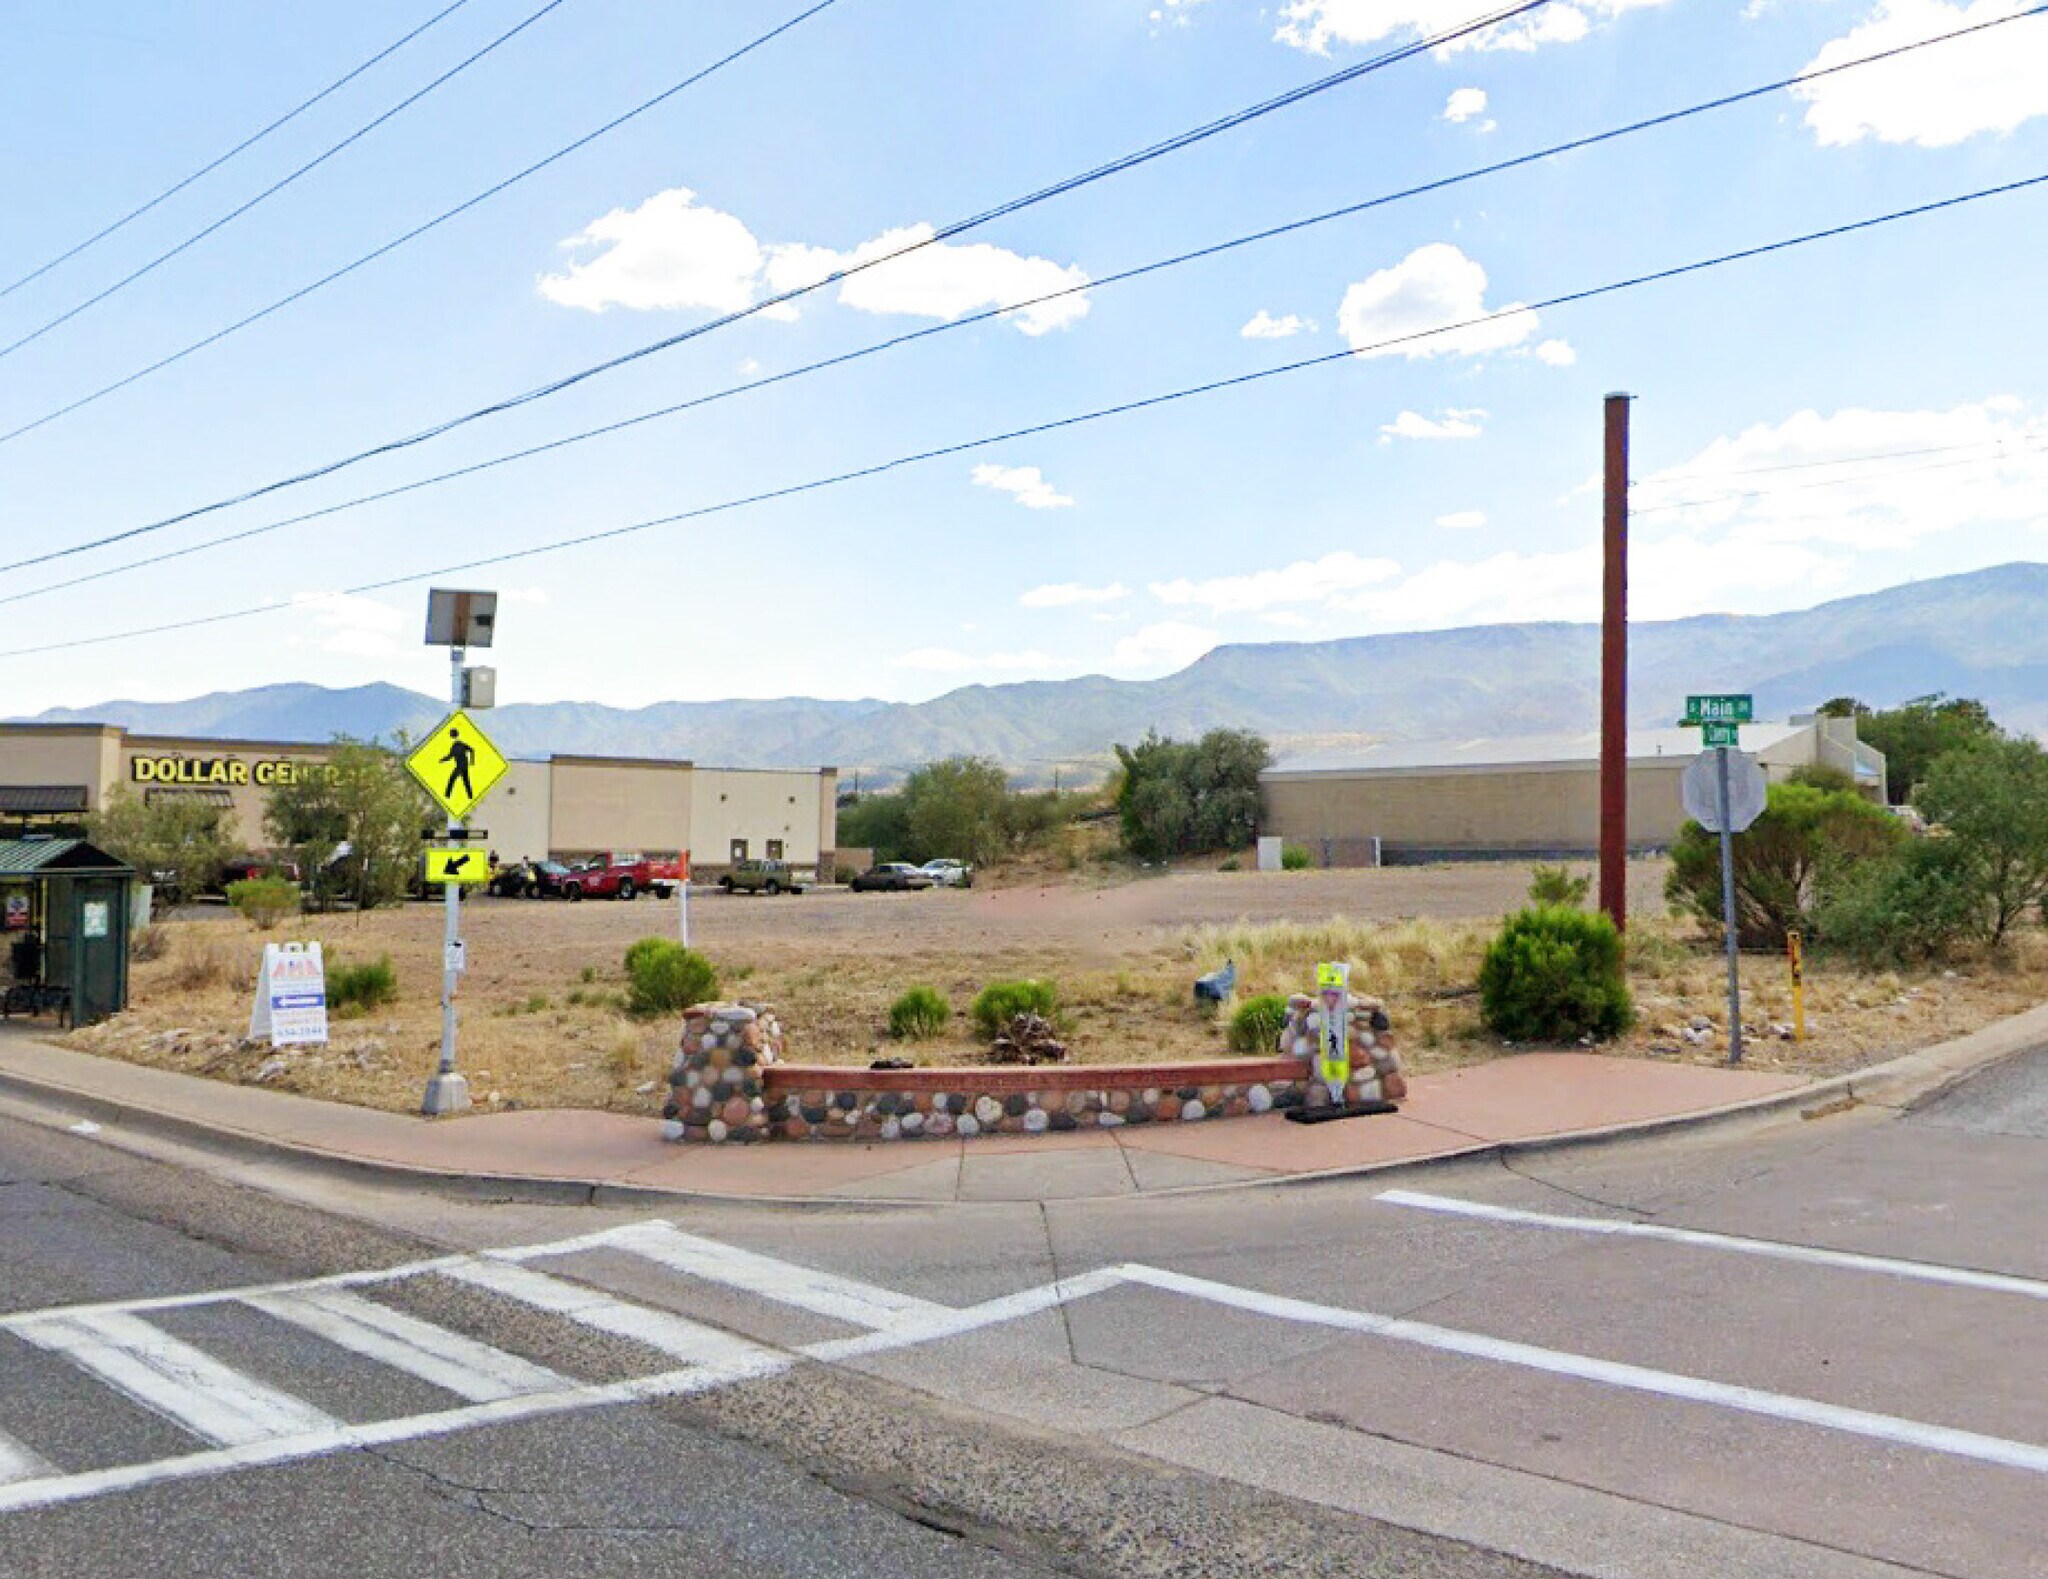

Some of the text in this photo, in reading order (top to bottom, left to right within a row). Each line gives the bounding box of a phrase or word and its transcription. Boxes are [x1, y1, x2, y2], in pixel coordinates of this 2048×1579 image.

[1701, 699, 1733, 715] Main
[133, 757, 364, 787] DOLLAR GENR
